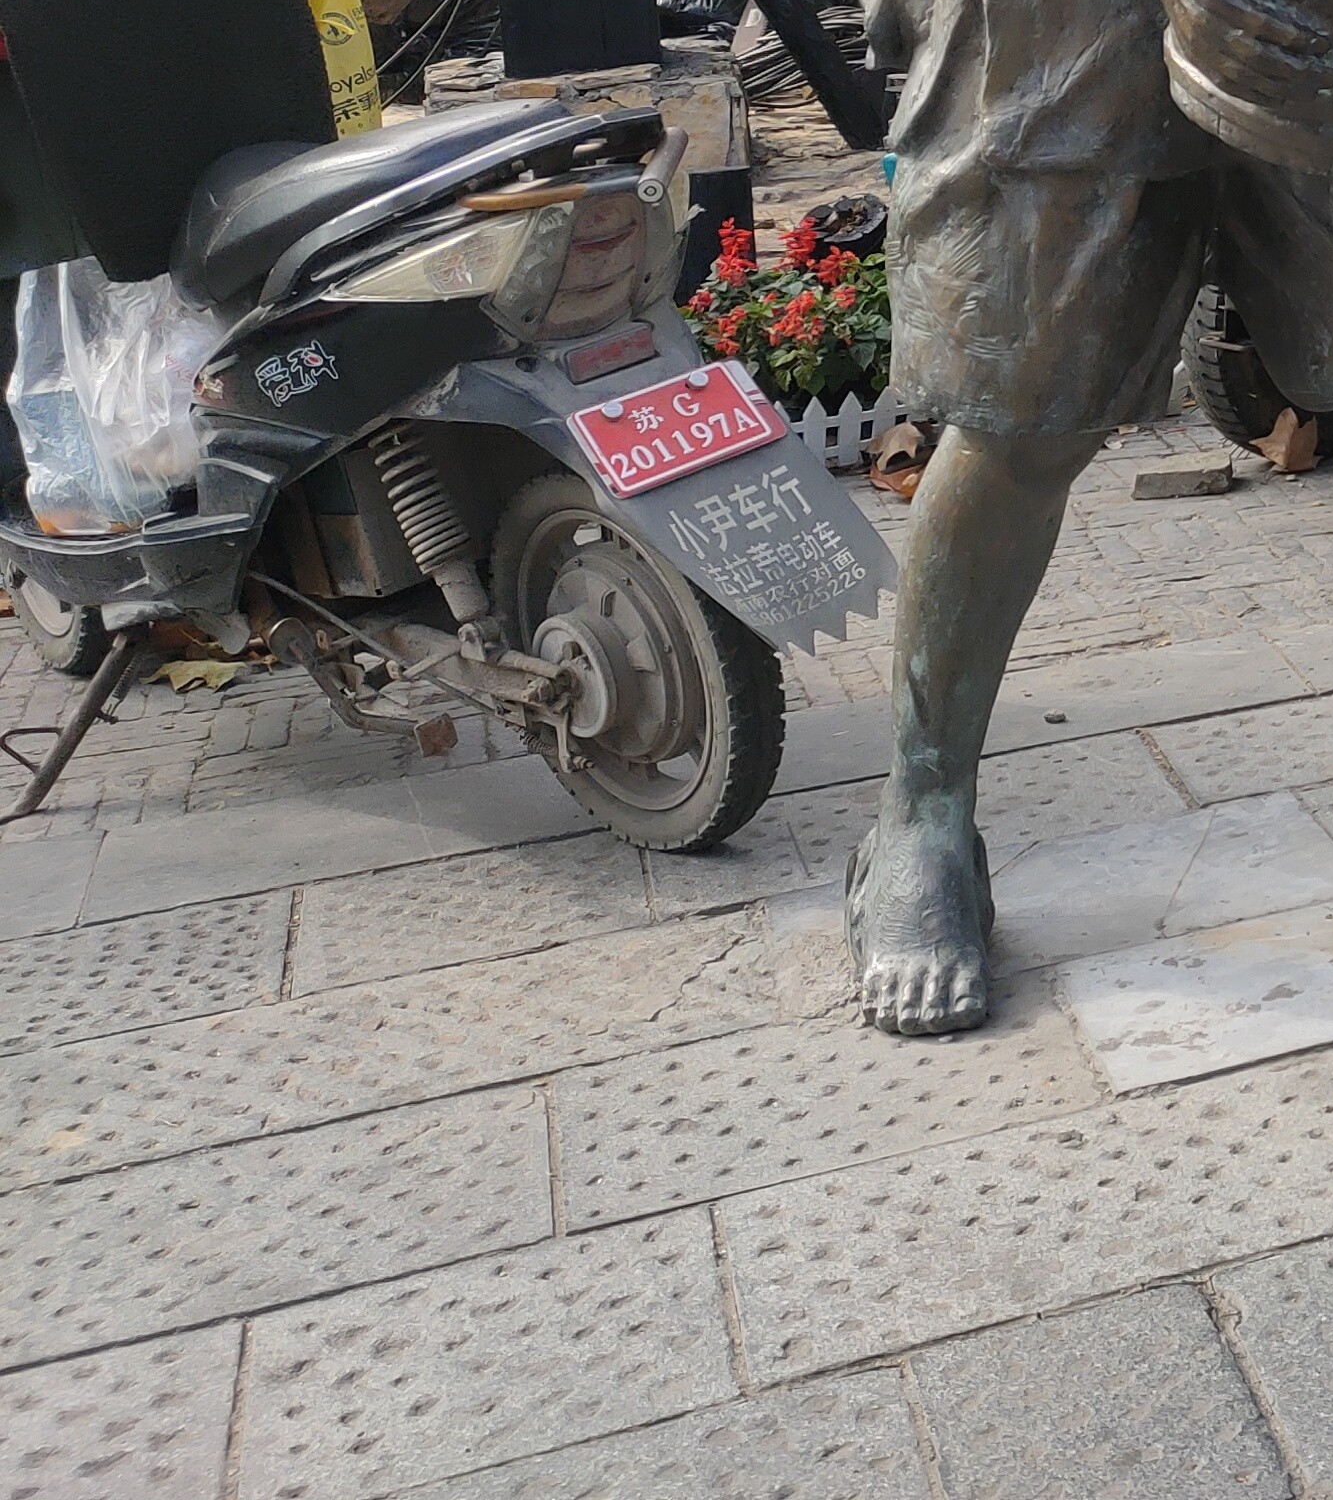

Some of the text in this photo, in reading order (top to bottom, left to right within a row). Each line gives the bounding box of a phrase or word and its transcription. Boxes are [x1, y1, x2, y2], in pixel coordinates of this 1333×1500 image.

[610, 407, 759, 479] 201197A
[627, 392, 700, 433] 苏 G
[667, 464, 812, 560] 小尹车行
